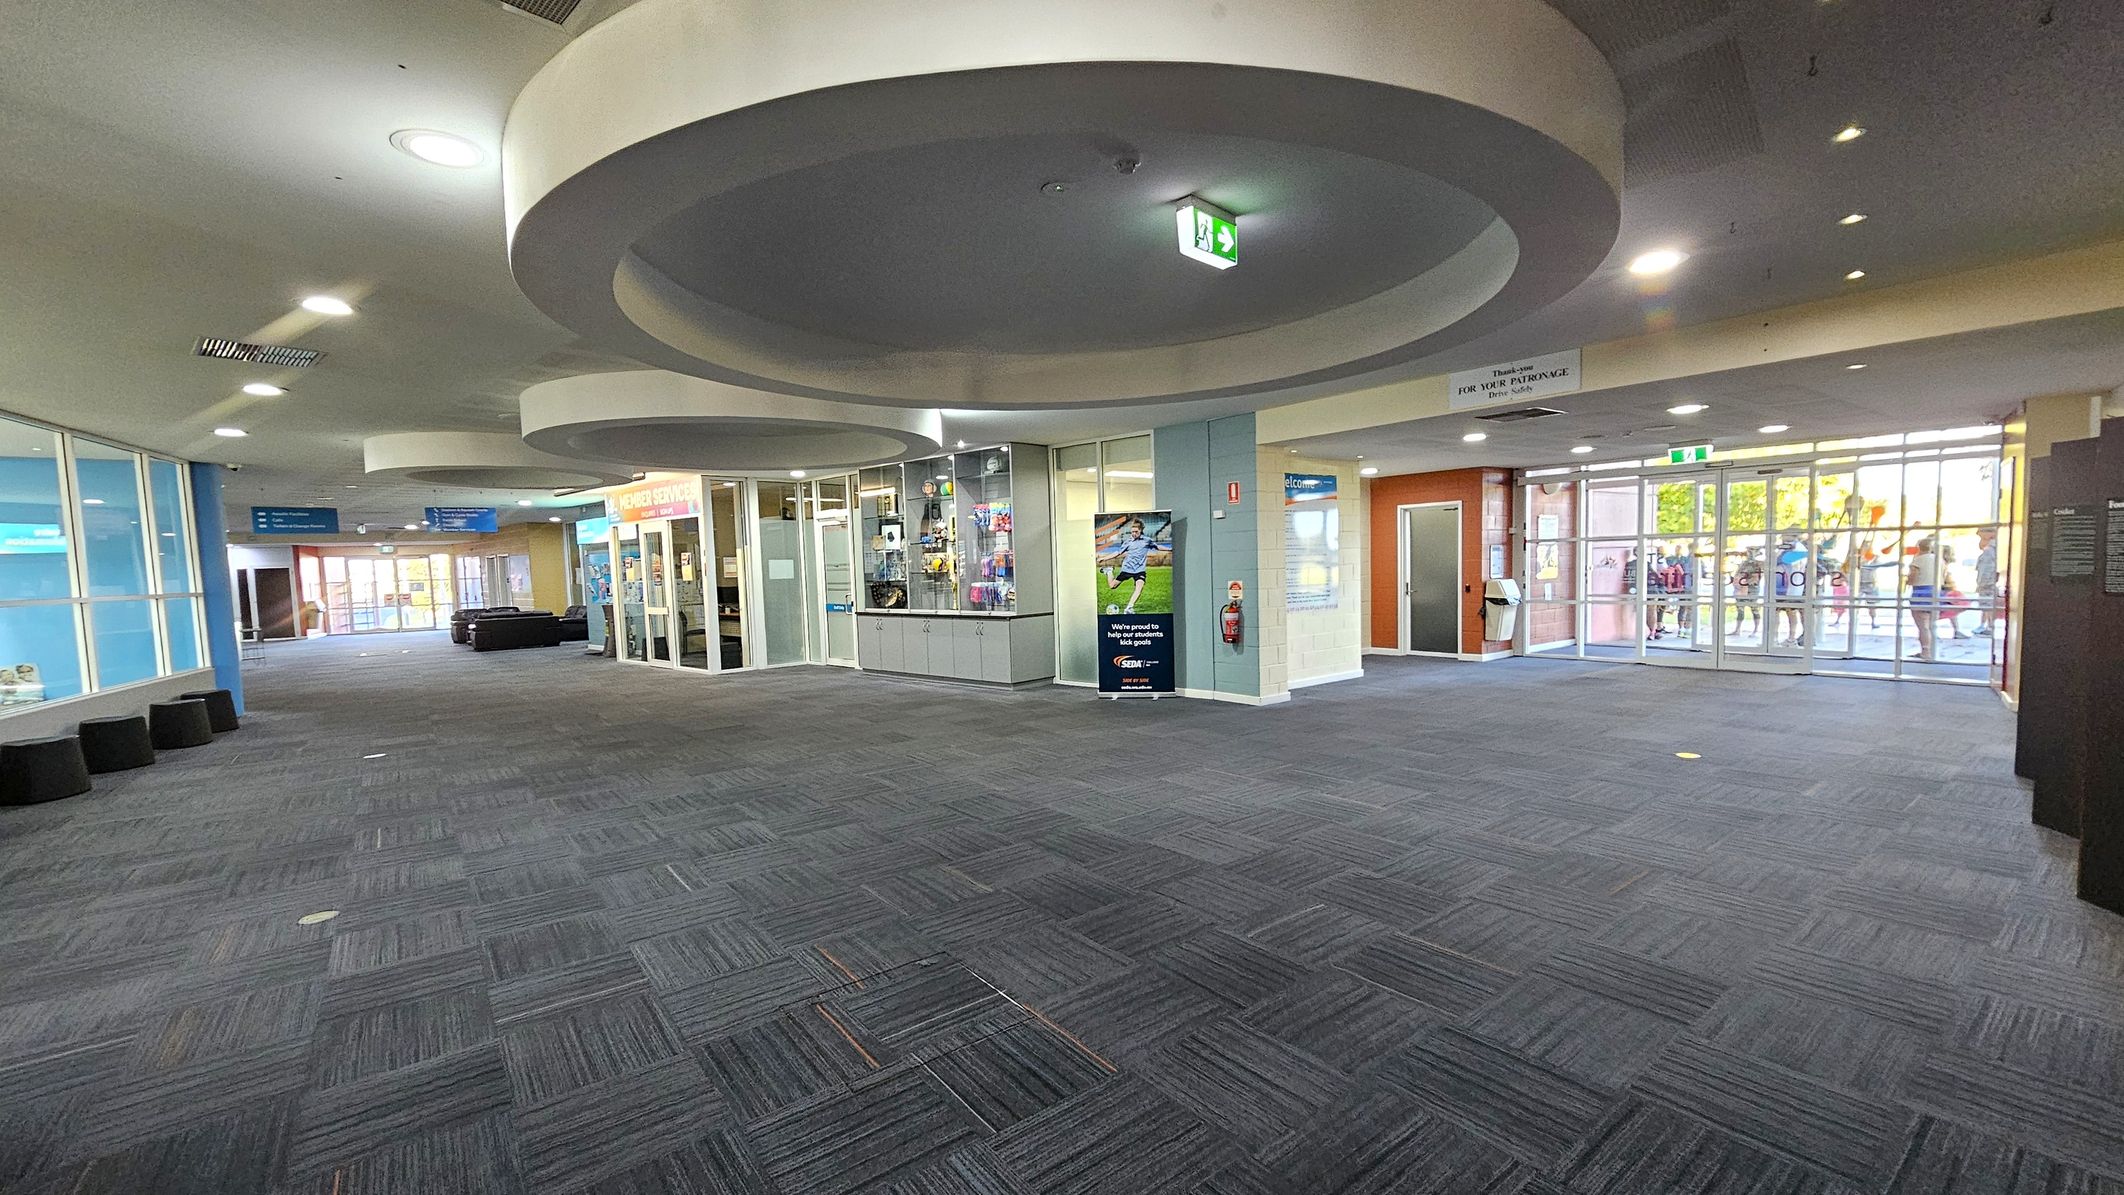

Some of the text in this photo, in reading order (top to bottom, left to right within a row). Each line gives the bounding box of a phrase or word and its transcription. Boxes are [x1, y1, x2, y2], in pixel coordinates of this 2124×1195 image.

[1493, 365, 1534, 377] Thank-you
[1458, 368, 1569, 395] FOR YOUR PATRONAGE
[1488, 384, 1534, 399] Drive Safely
[1284, 476, 1315, 488] elcome
[620, 482, 697, 510] MEMBER SERVICES
[1121, 660, 1142, 668] SEDA
